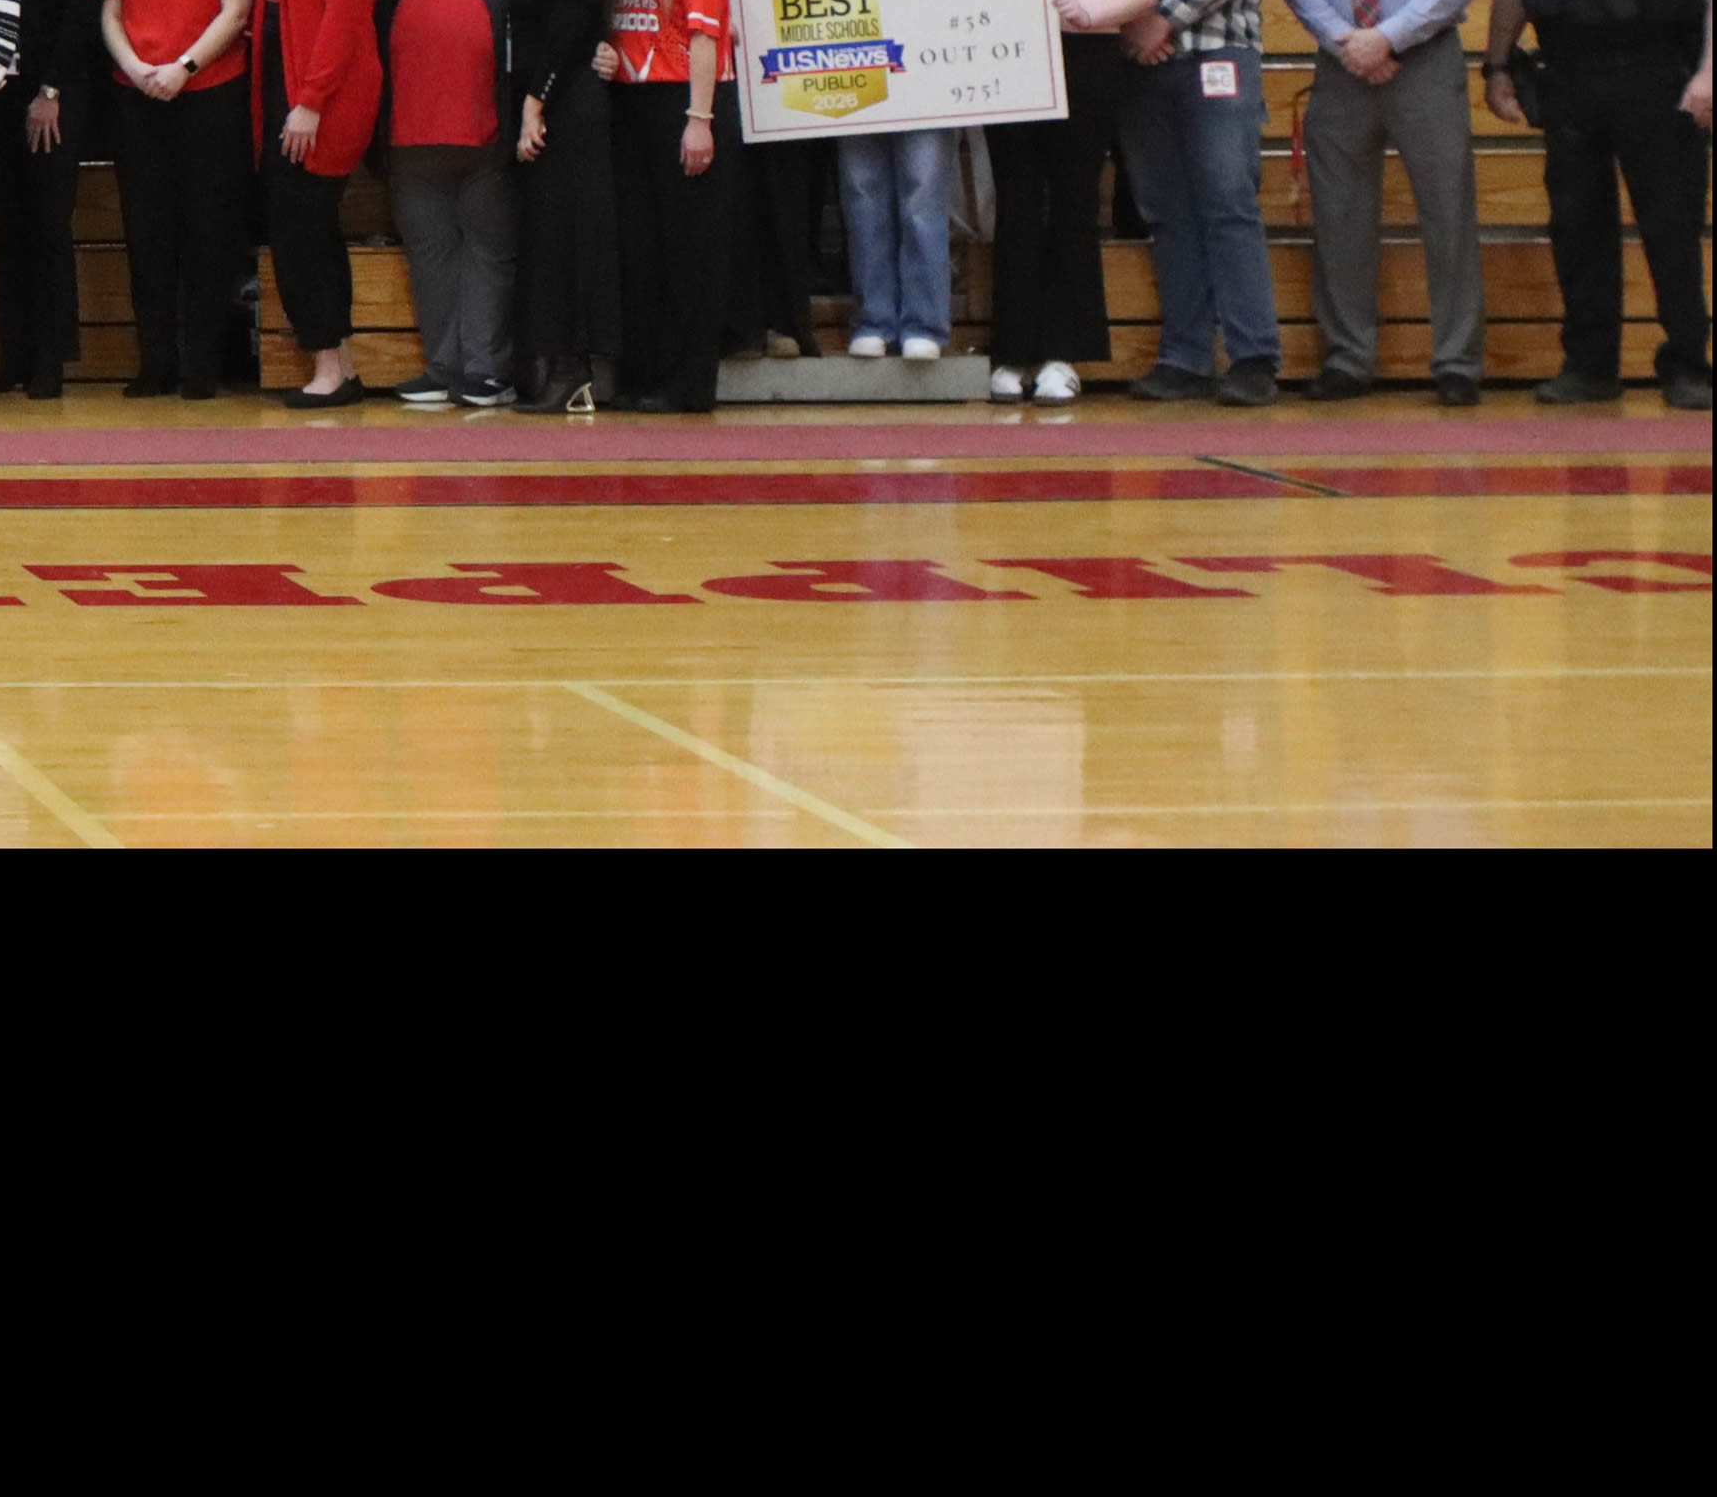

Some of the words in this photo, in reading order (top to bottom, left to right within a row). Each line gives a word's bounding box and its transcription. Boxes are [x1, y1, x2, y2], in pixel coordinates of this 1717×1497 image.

[780, 24, 824, 44] MIDDLE
[825, 17, 880, 39] SCHOOLS
[918, 44, 977, 66] OUT
[992, 39, 1028, 61] OF
[802, 73, 868, 93] PUBLIC
[950, 78, 1001, 105] 975!
